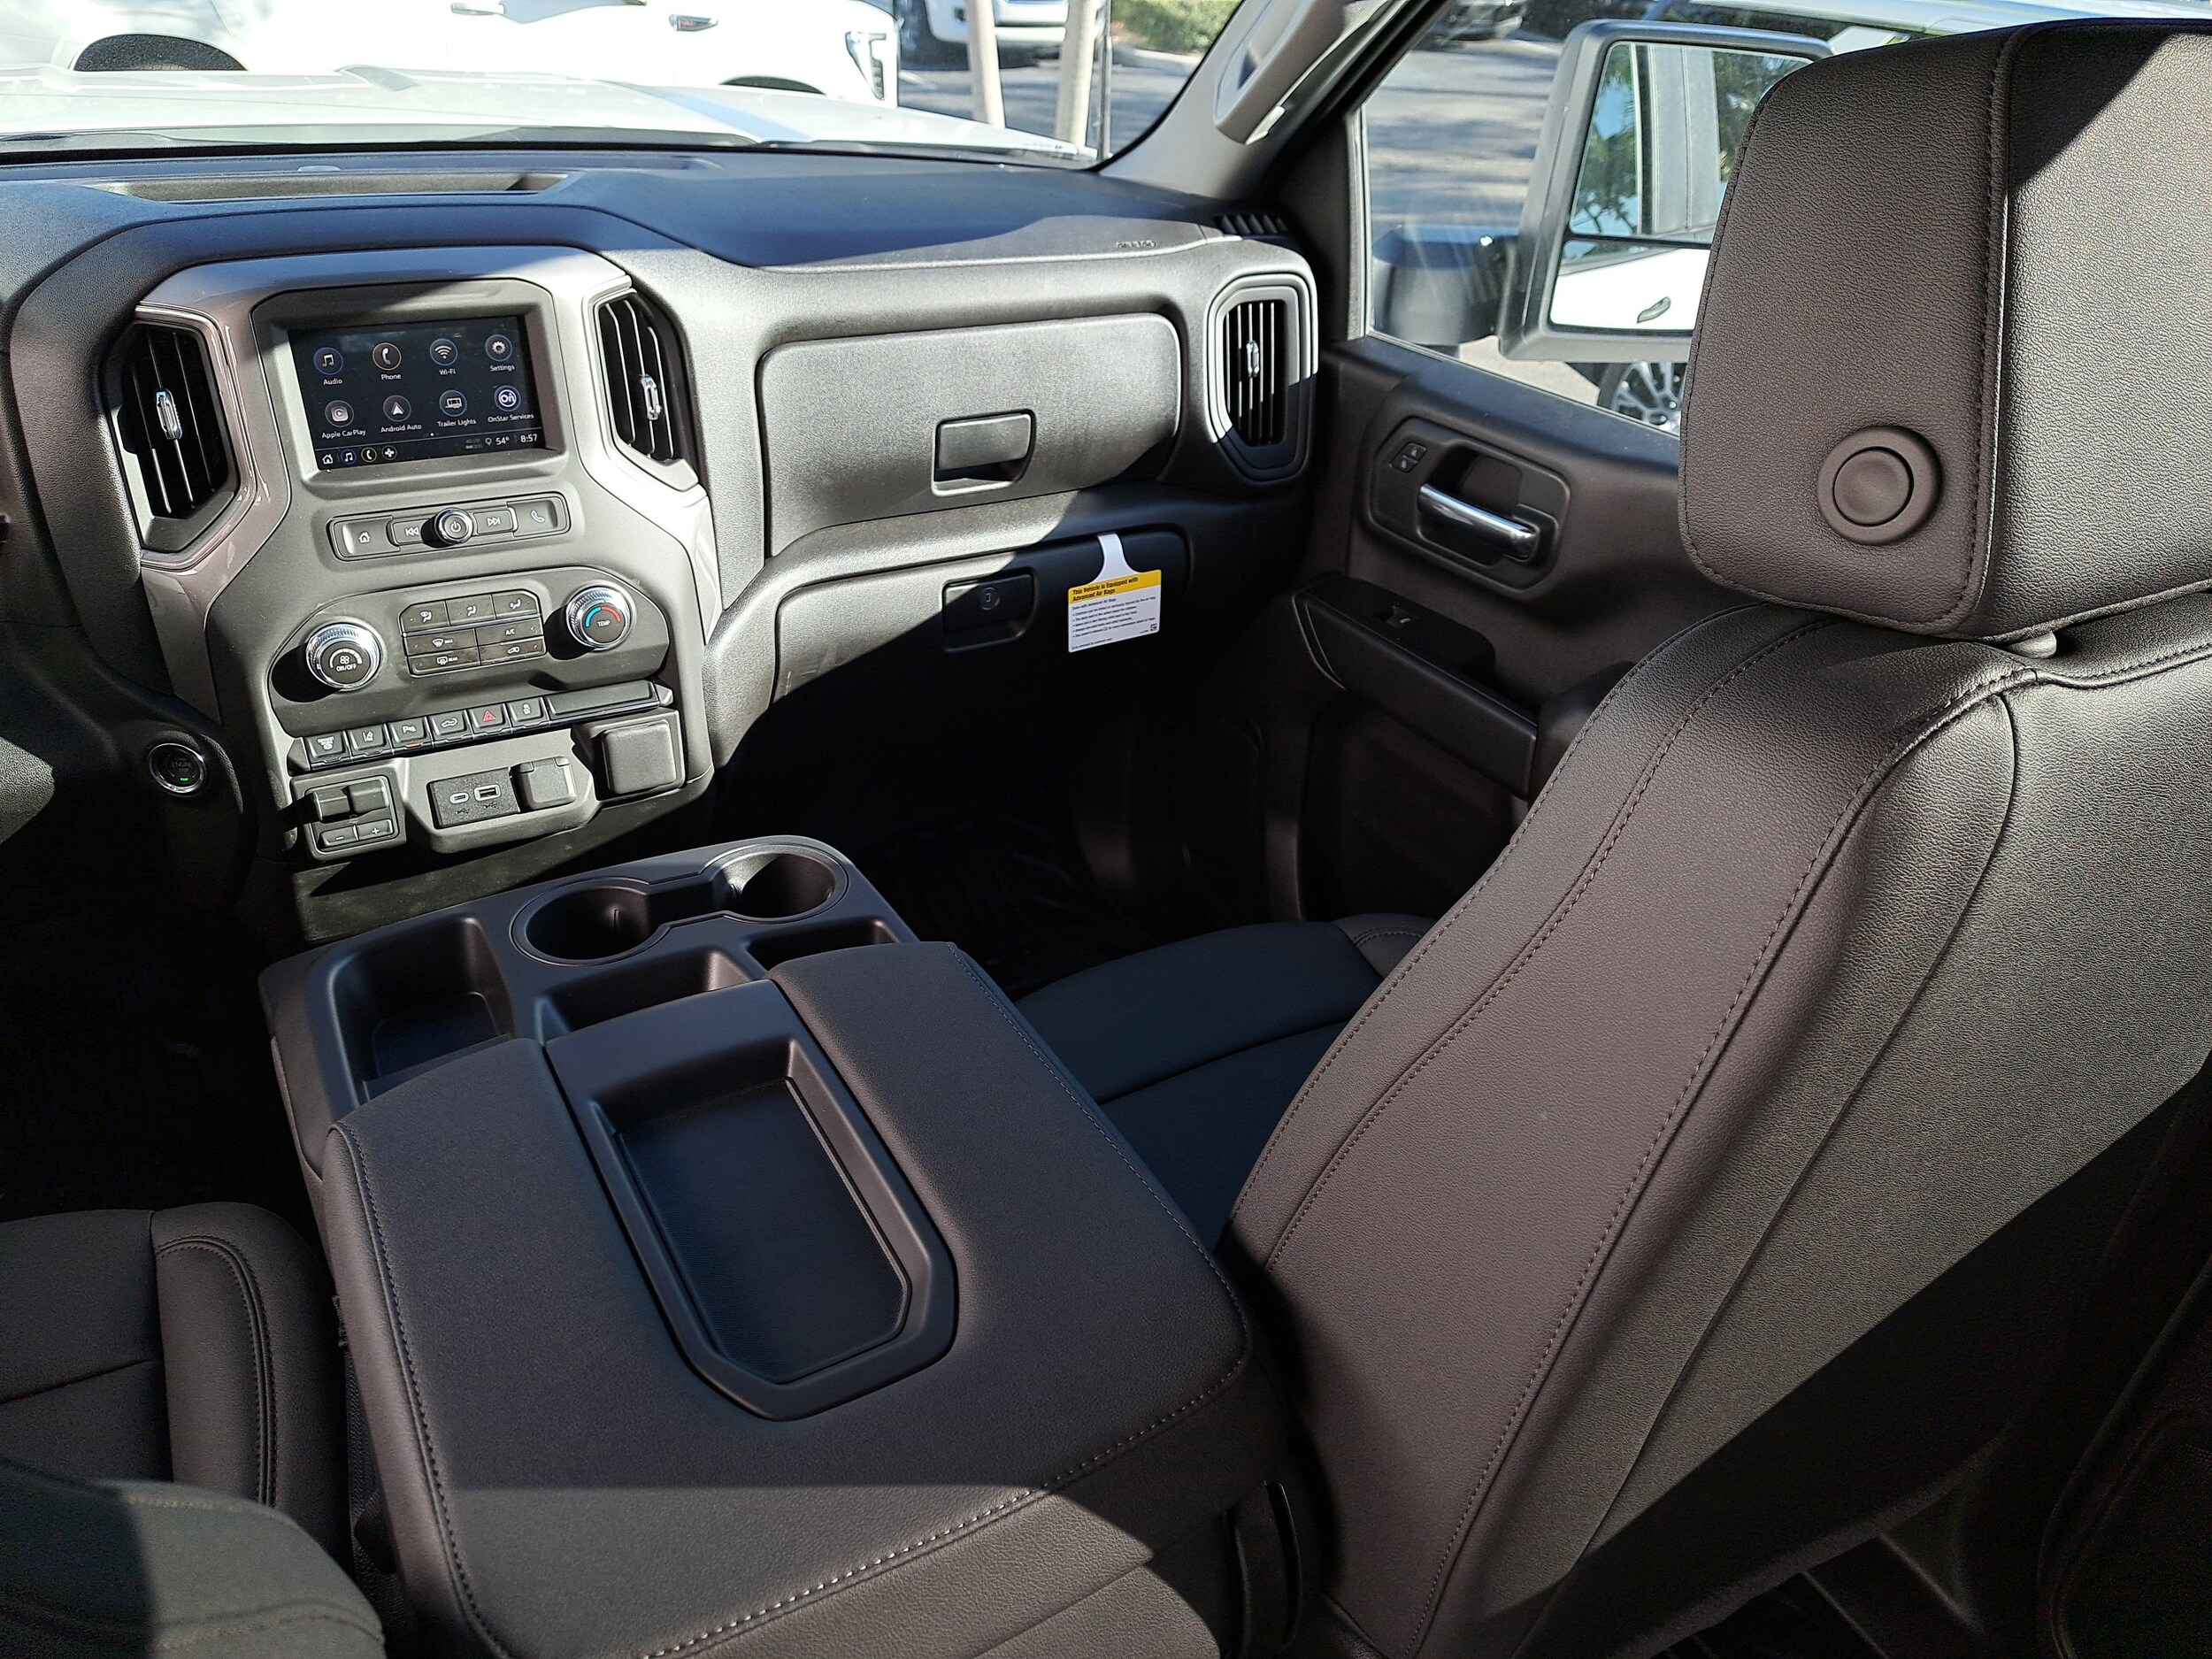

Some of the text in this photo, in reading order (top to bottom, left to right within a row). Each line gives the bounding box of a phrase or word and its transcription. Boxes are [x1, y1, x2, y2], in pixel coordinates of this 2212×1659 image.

[457, 418, 477, 426] Lights
[321, 431, 341, 440] Apple
[520, 434, 538, 443] 8:57
[1106, 579, 1128, 588] Equipped
[1073, 591, 1095, 601] Advanced
[336, 663, 357, 672] ON/OFF
